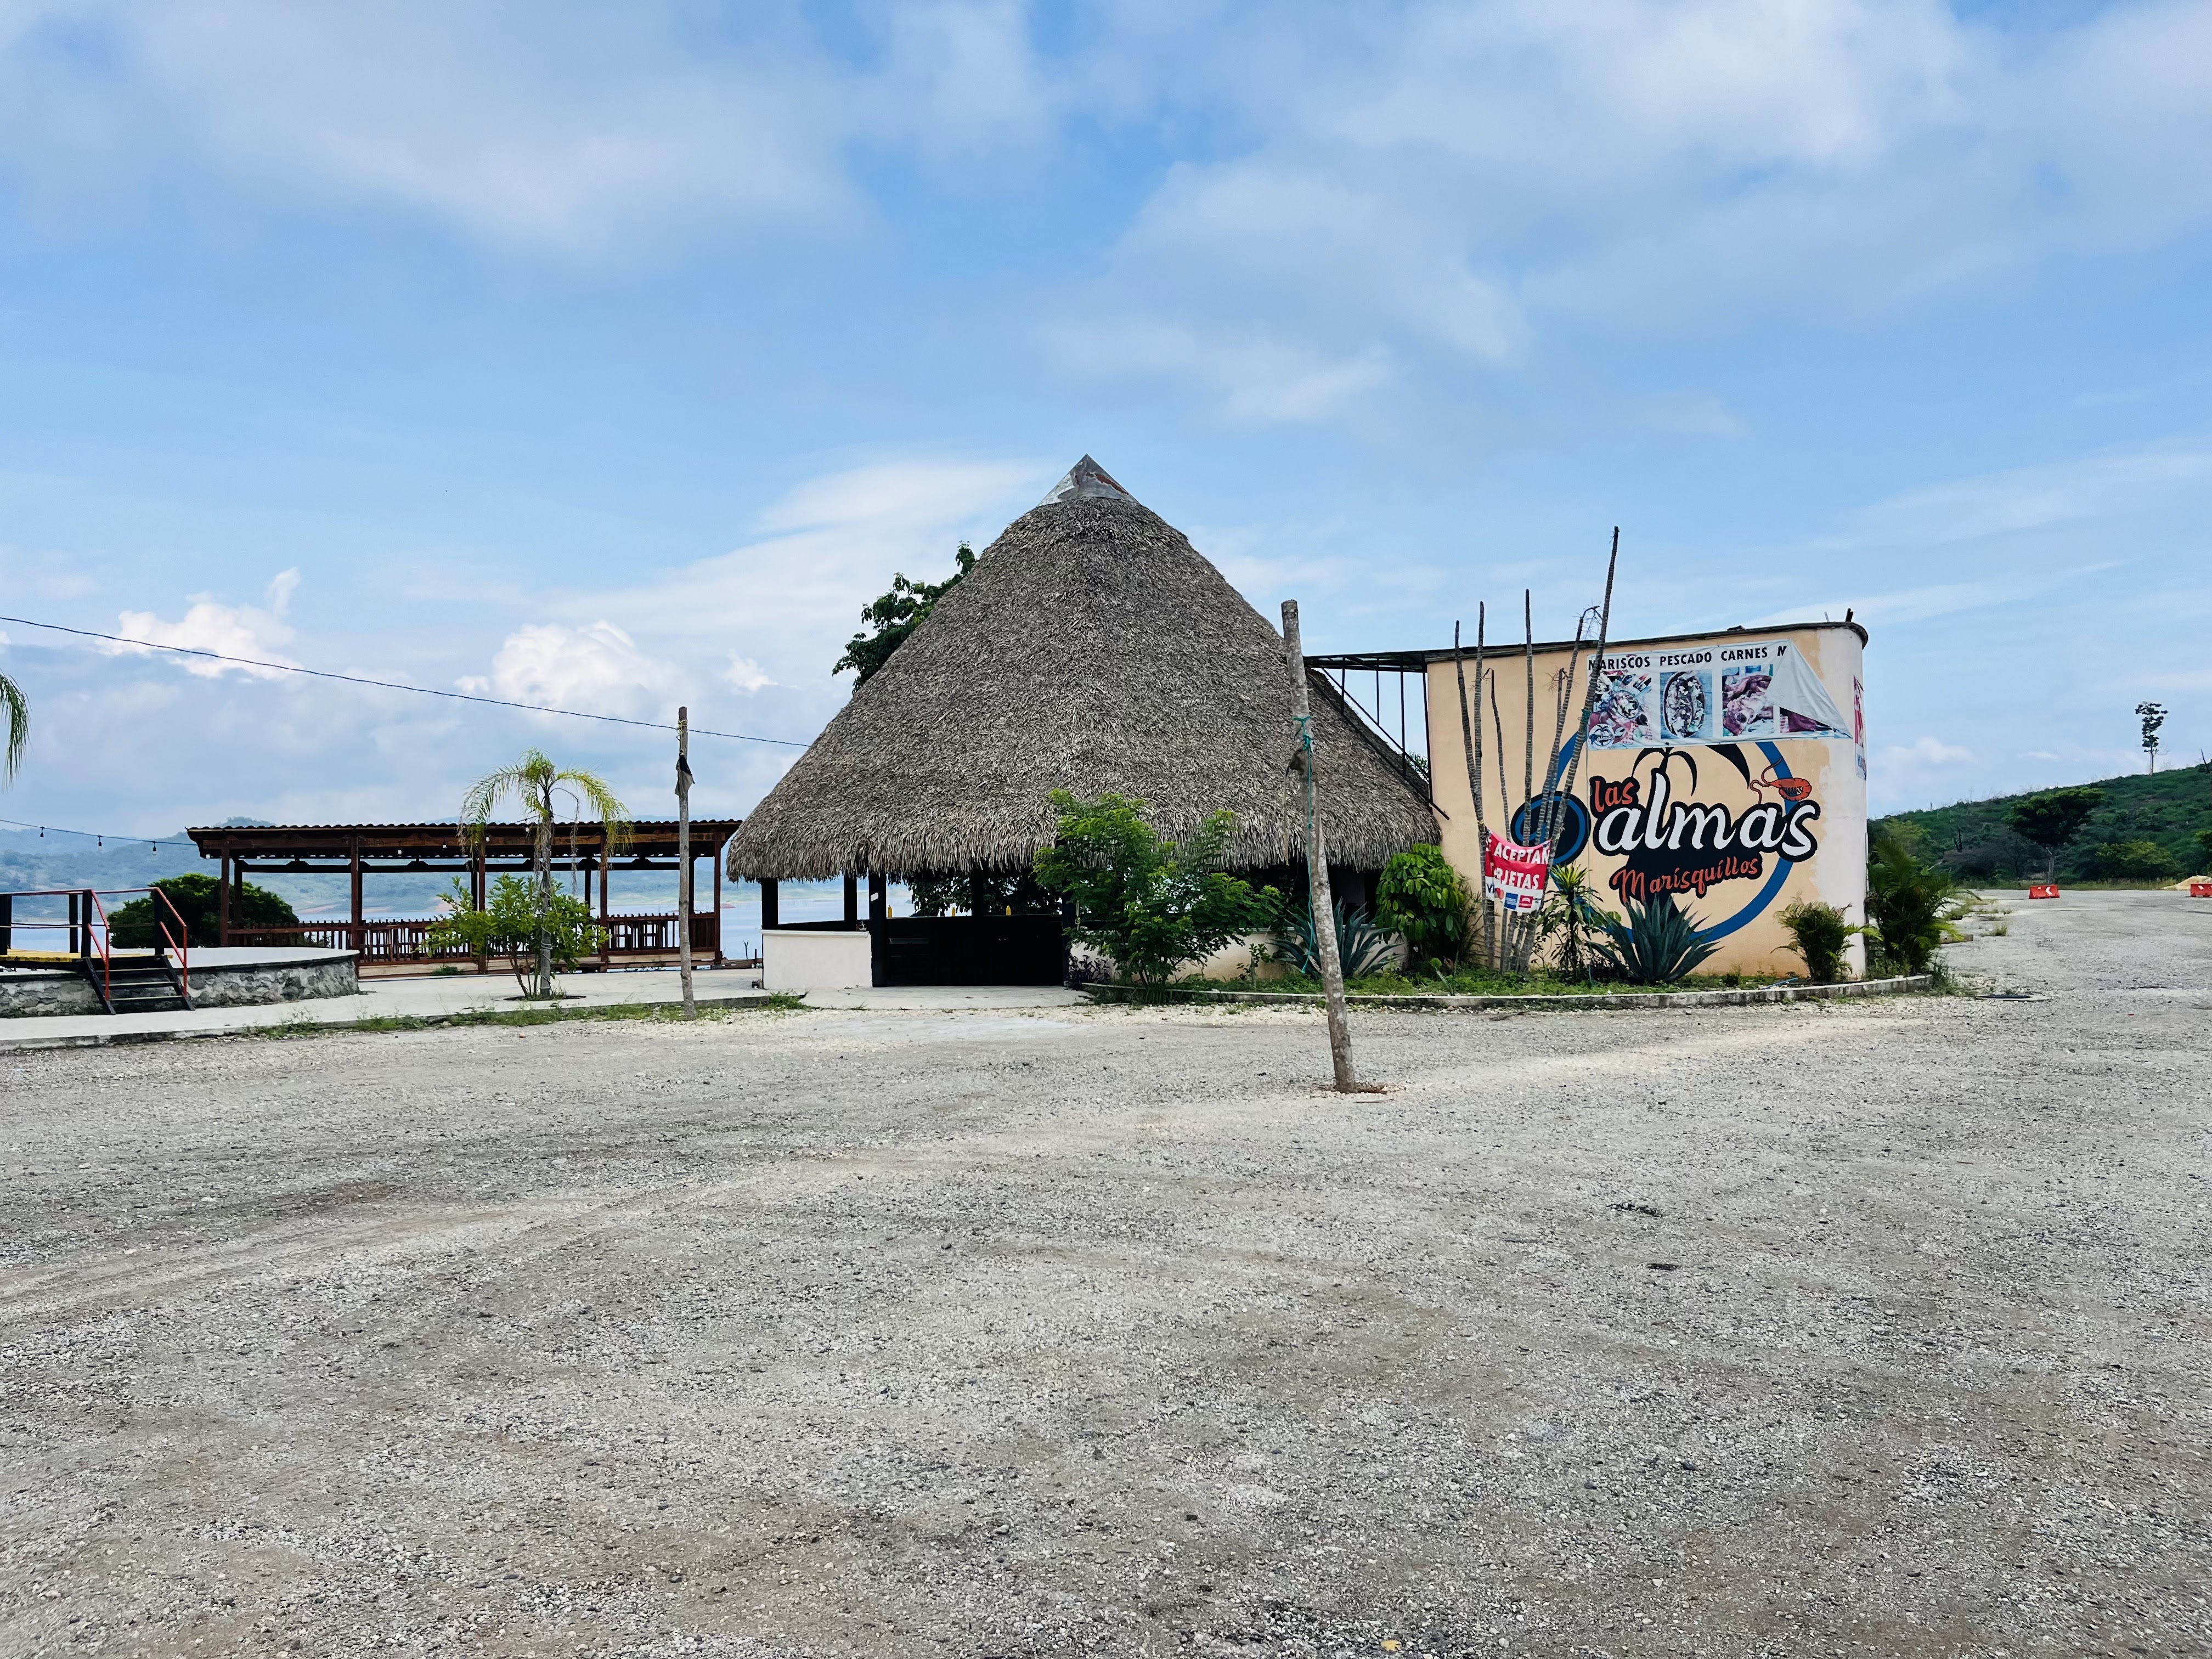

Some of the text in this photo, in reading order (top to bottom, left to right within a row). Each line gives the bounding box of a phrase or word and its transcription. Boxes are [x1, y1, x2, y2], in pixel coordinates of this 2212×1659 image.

[1660, 652, 1712, 666] PESCADO
[1721, 647, 1768, 661] CARNES
[1594, 780, 1633, 812] las
[1493, 842, 1550, 865] ACEPTAN
[1612, 856, 1758, 903] Marisquillos
